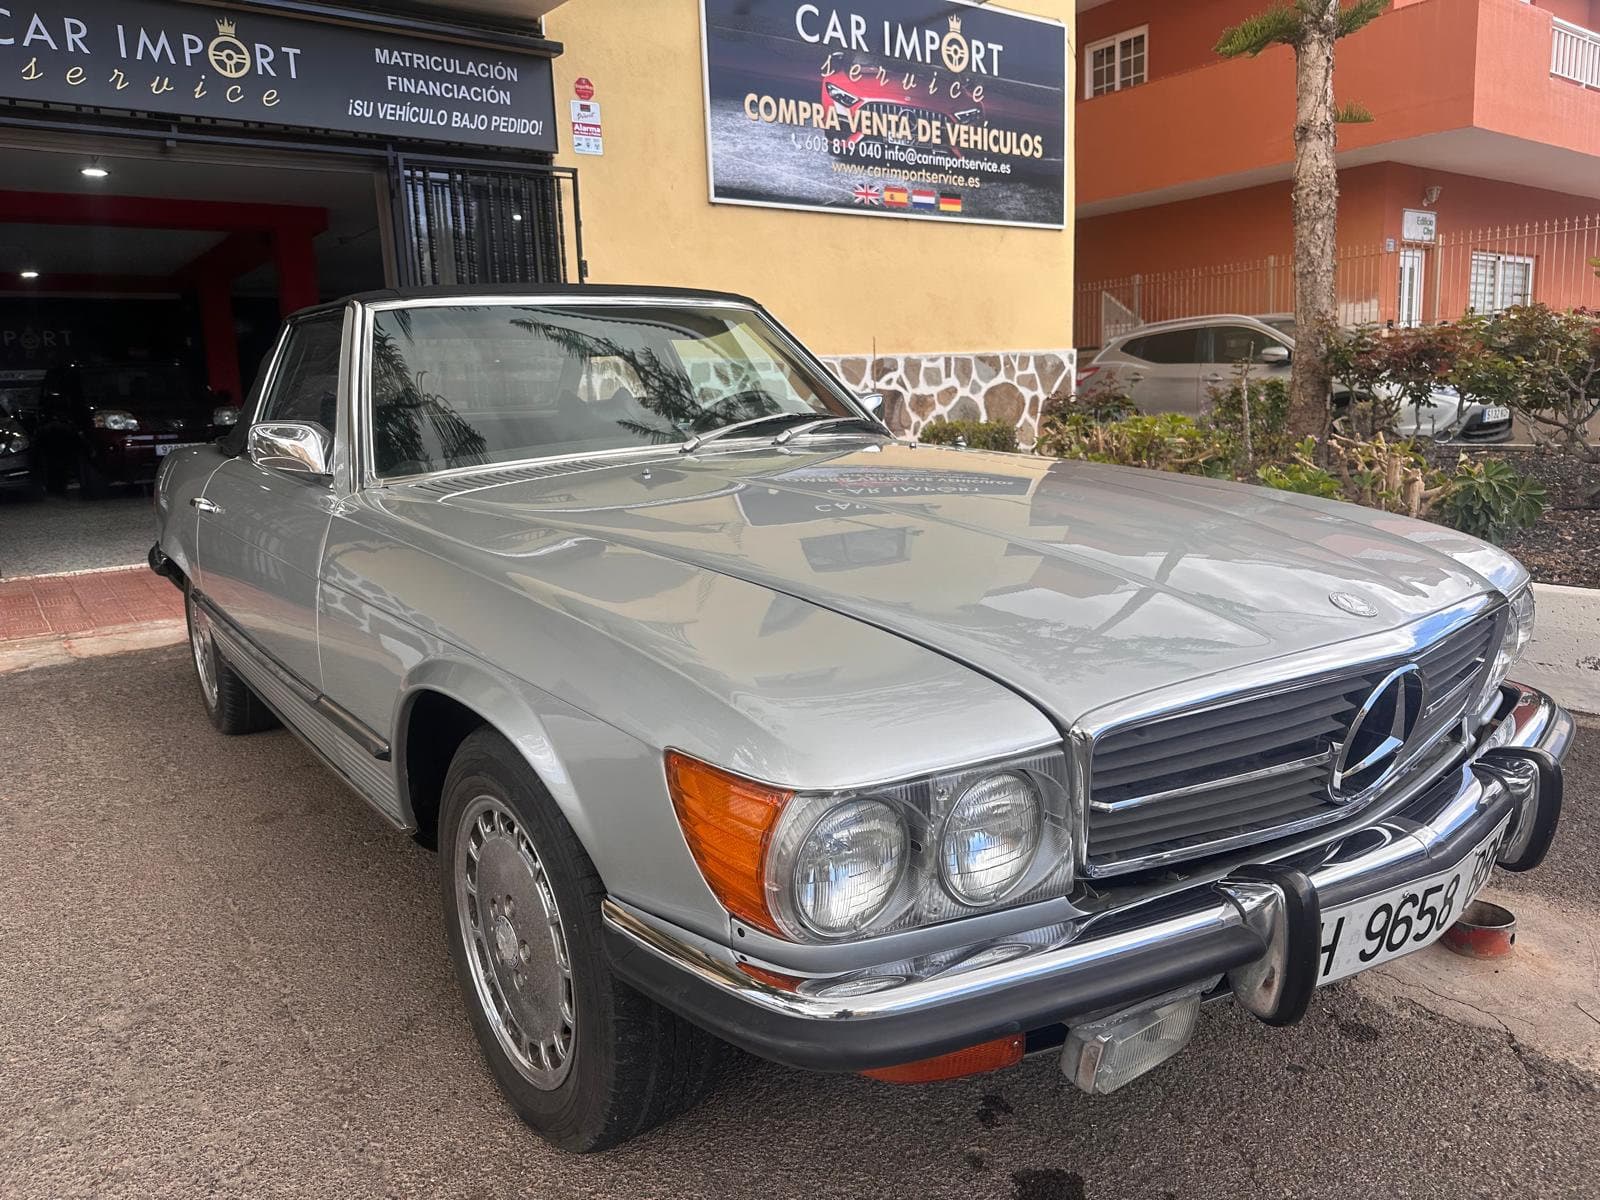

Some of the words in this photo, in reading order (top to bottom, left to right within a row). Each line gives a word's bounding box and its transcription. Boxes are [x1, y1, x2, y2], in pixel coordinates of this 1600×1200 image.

[117, 23, 301, 79] IMPORT
[795, 4, 870, 52] CAR
[884, 20, 1003, 77] IMPORT
[22, 57, 281, 107] service
[375, 48, 518, 82] MATRICULACIÓN
[820, 51, 985, 102] service
[387, 75, 512, 105] FINANCIACIÓN
[348, 99, 374, 117] ¡SU
[377, 102, 448, 126] VEHÍCULO
[452, 112, 488, 131] BAJO
[491, 115, 544, 136] PEDIDO!
[574, 123, 601, 134] Alarma
[744, 92, 841, 132] COMPRA
[847, 108, 912, 141] VENTA
[917, 118, 942, 145] DE
[946, 121, 1043, 159] VEHÍCULOS
[805, 135, 829, 152] 603
[833, 138, 855, 156] 819
[859, 142, 882, 159] 040
[885, 144, 1011, 175] info@carimportservice.es
[832, 160, 981, 188] www.carimportservice.es
[1321, 916, 1346, 977] H
[1358, 873, 1461, 963] 9658
